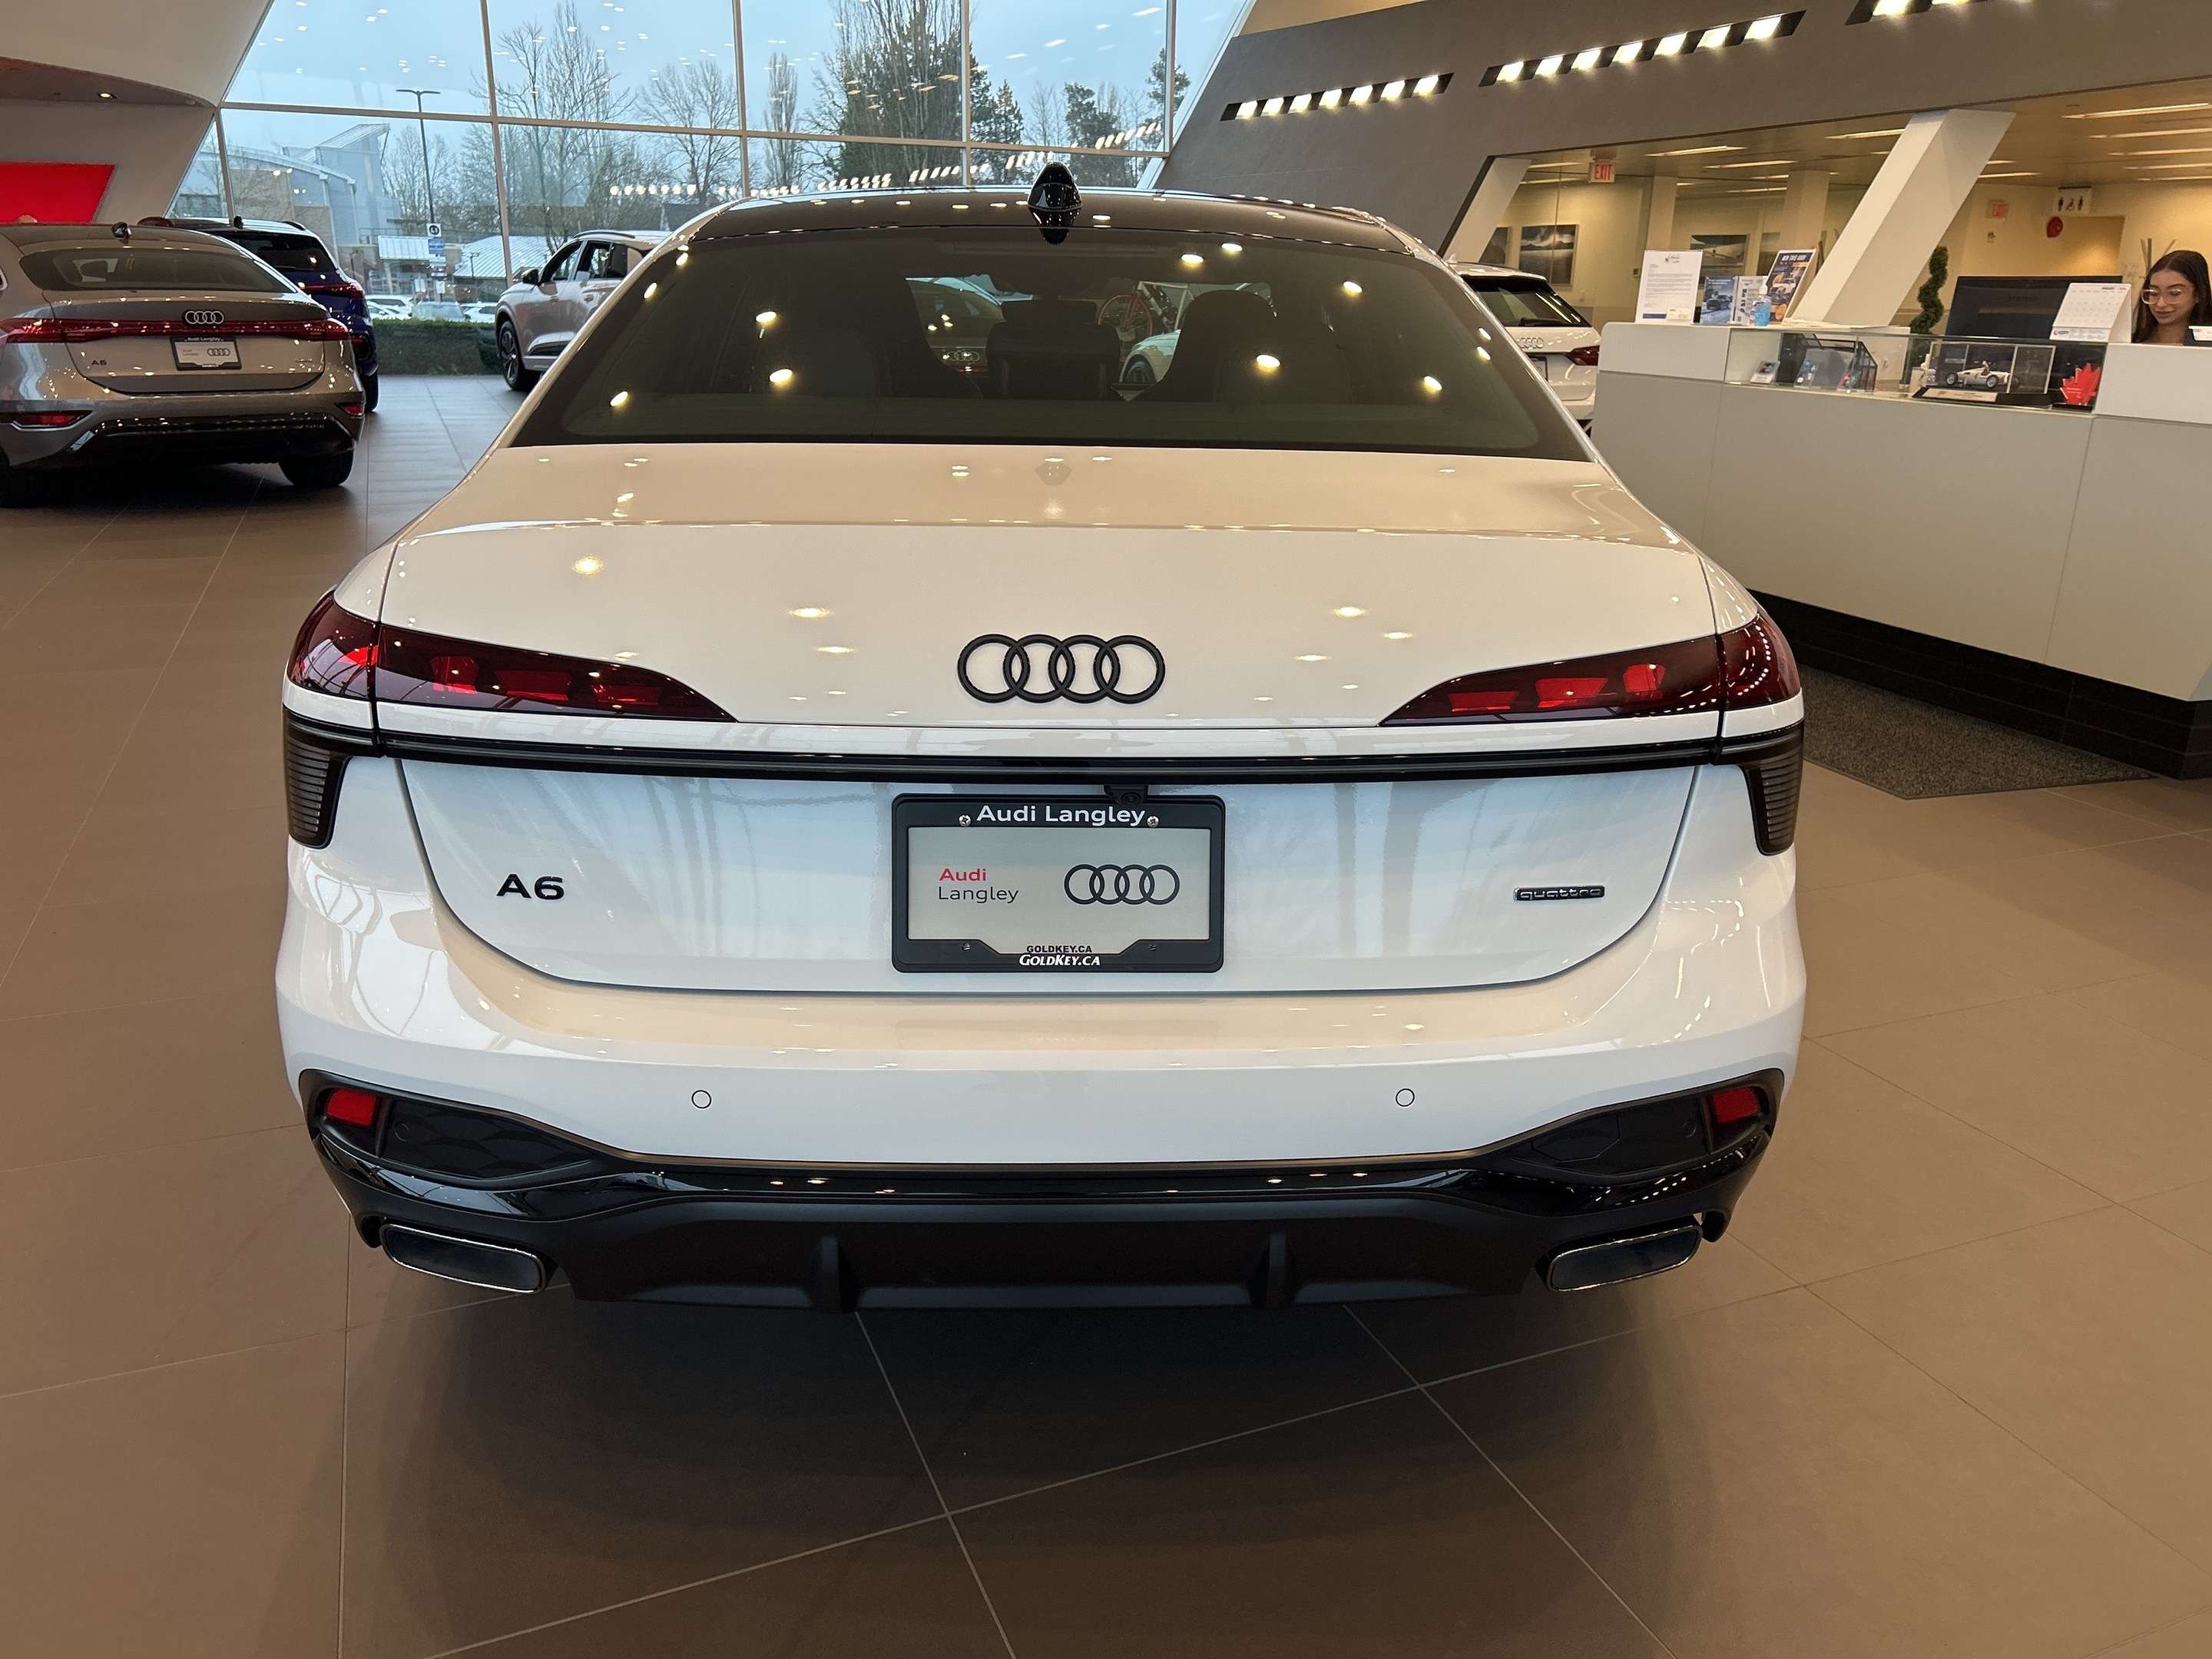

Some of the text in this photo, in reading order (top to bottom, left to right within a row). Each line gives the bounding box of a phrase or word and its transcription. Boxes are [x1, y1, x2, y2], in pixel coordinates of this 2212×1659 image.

[1594, 164, 1613, 180] EXIT
[976, 805, 1145, 826] Audi Langley
[939, 868, 986, 881] Audi
[496, 873, 565, 900] A6
[939, 886, 1019, 904] Langley
[1519, 888, 1602, 900] quattro
